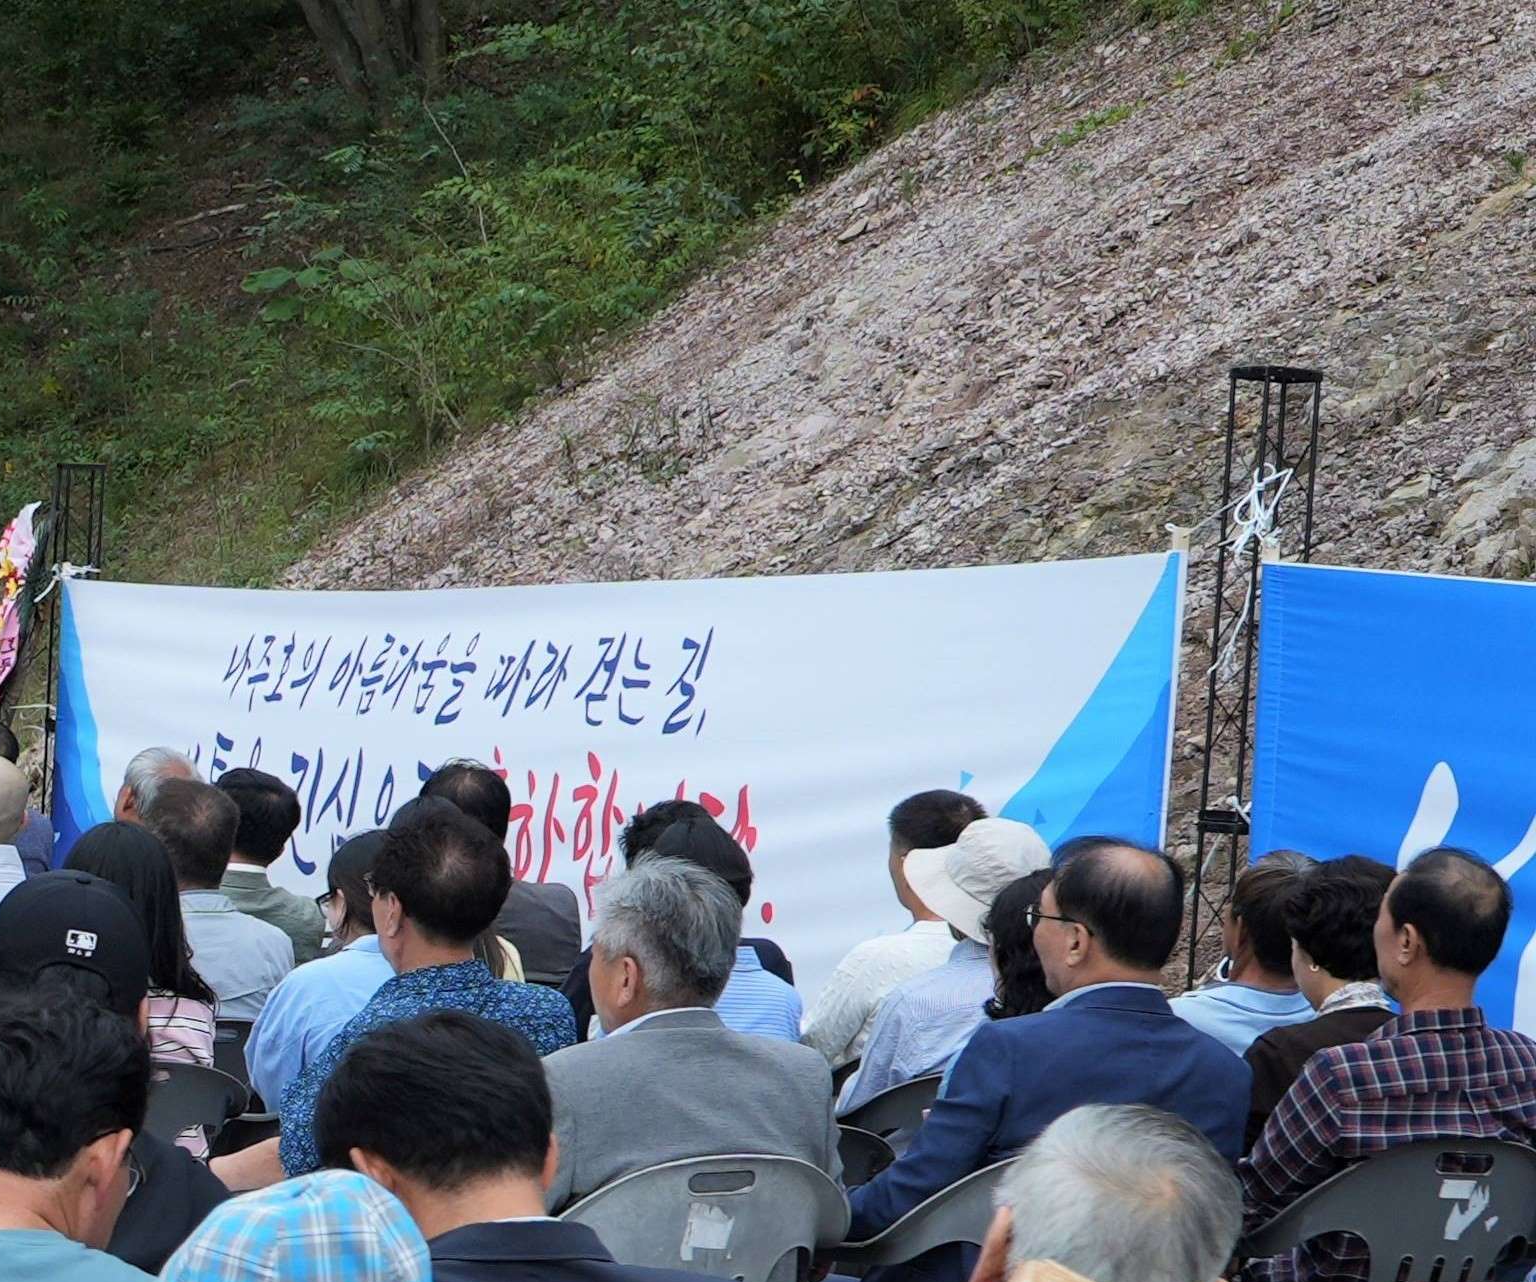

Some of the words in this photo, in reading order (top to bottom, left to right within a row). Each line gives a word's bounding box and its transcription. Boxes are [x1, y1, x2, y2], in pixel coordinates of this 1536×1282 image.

[221, 630, 333, 713] 나주호의
[328, 631, 481, 726] 아름다움을
[483, 639, 573, 718] 따라
[573, 631, 652, 727] 걷는
